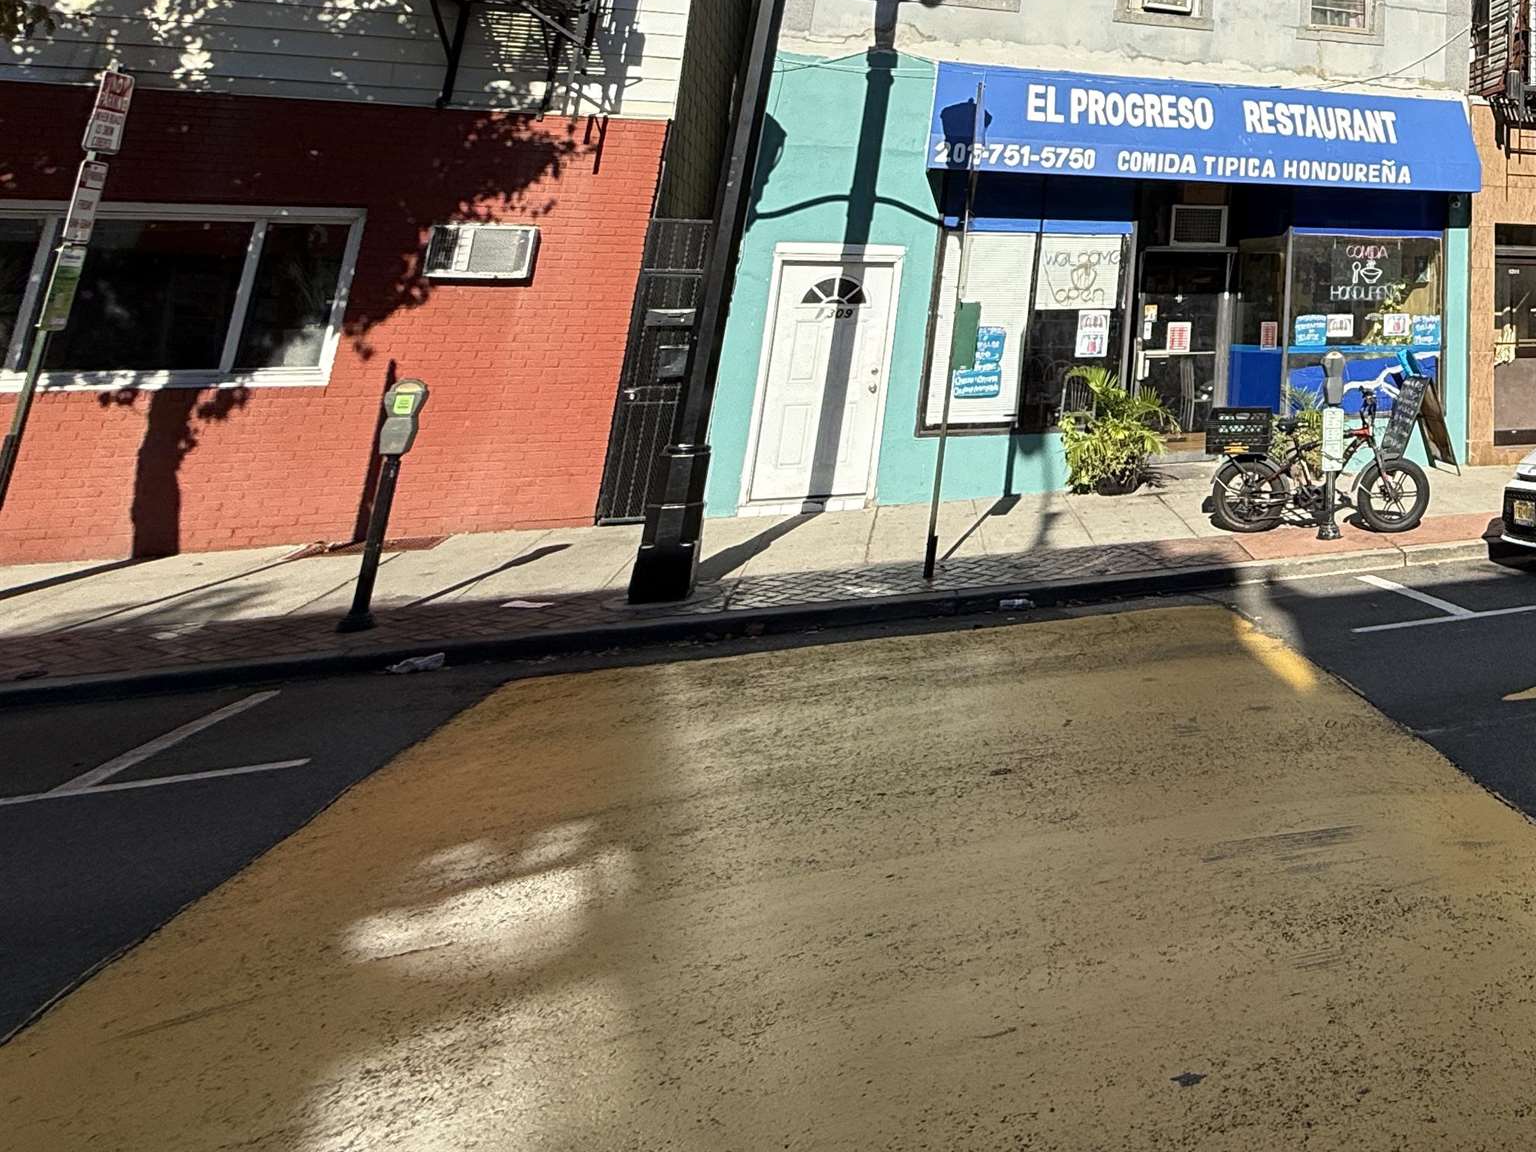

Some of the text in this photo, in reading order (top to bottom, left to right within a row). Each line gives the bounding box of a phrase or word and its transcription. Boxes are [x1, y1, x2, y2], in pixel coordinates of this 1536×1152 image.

[1026, 84, 1399, 145] EL PROGRESO RESTAURANT
[1117, 150, 1197, 175] COMIDA
[1203, 155, 1276, 179] TIPICA
[1283, 159, 1412, 185] HONDUREÑA
[1346, 245, 1389, 259] COMIDA
